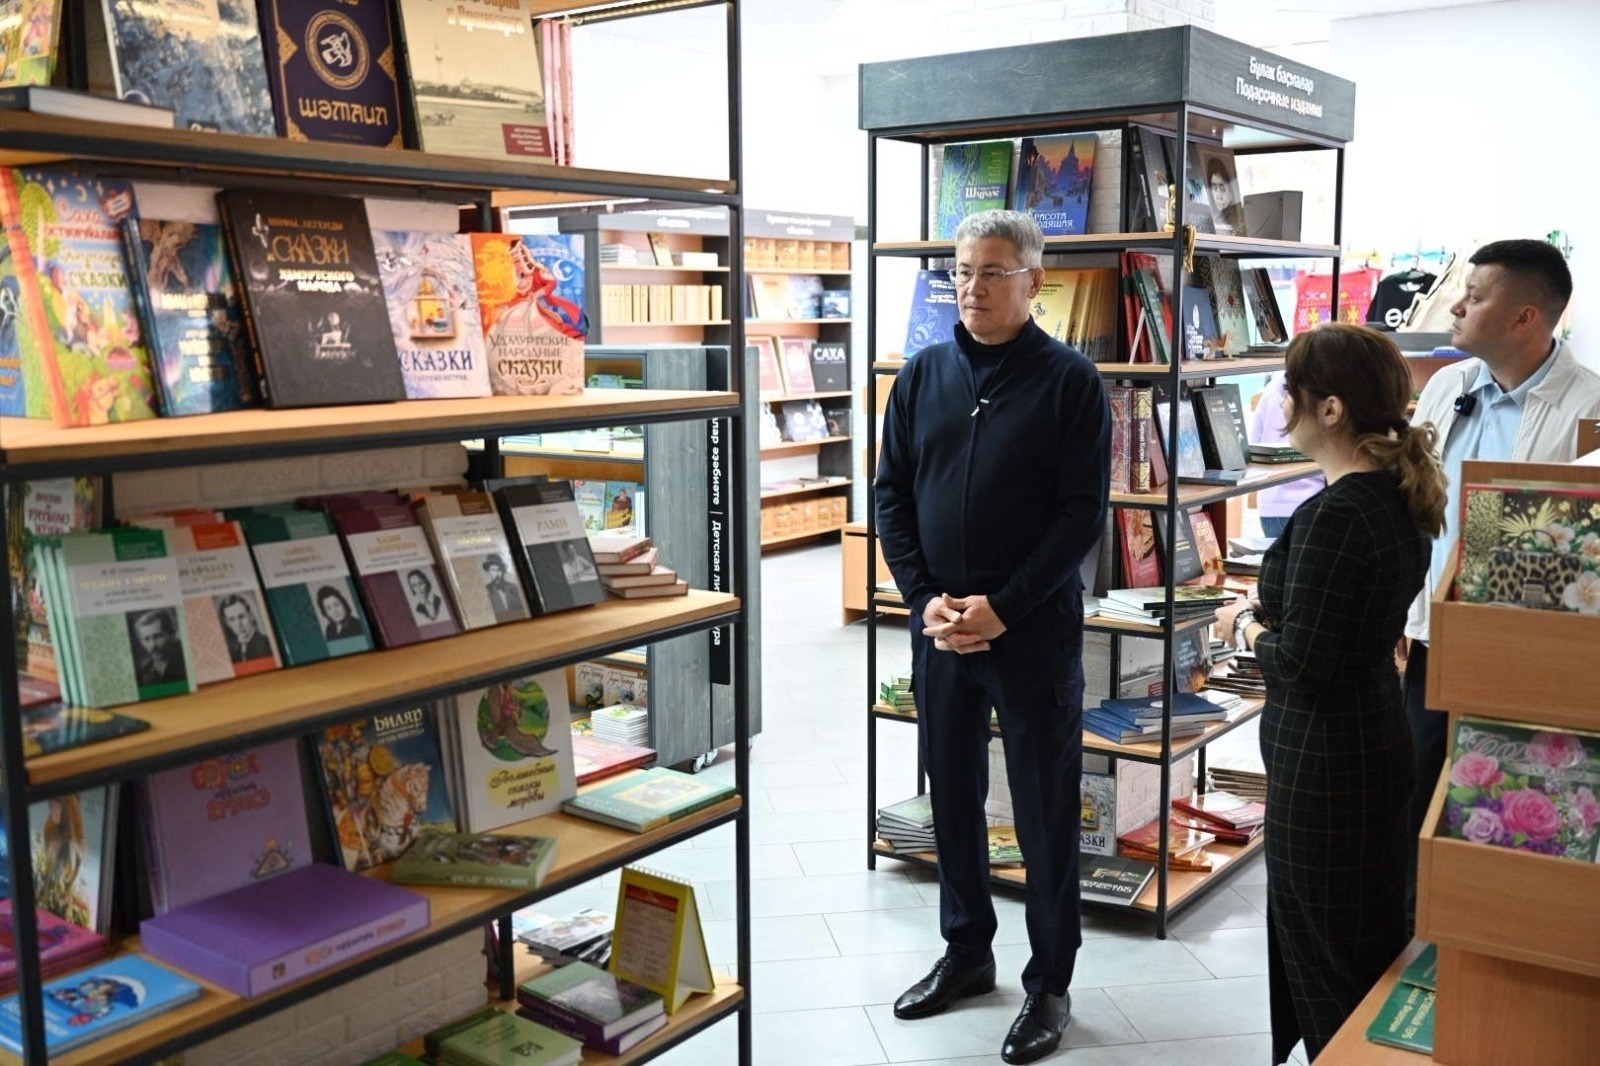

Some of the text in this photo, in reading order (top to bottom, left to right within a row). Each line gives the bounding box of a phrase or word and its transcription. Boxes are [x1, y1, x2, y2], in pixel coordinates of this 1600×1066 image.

[1236, 77, 1290, 108] Подарочные
[712, 520, 722, 572] Детская
[1080, 833, 1106, 848] АЗКИ
